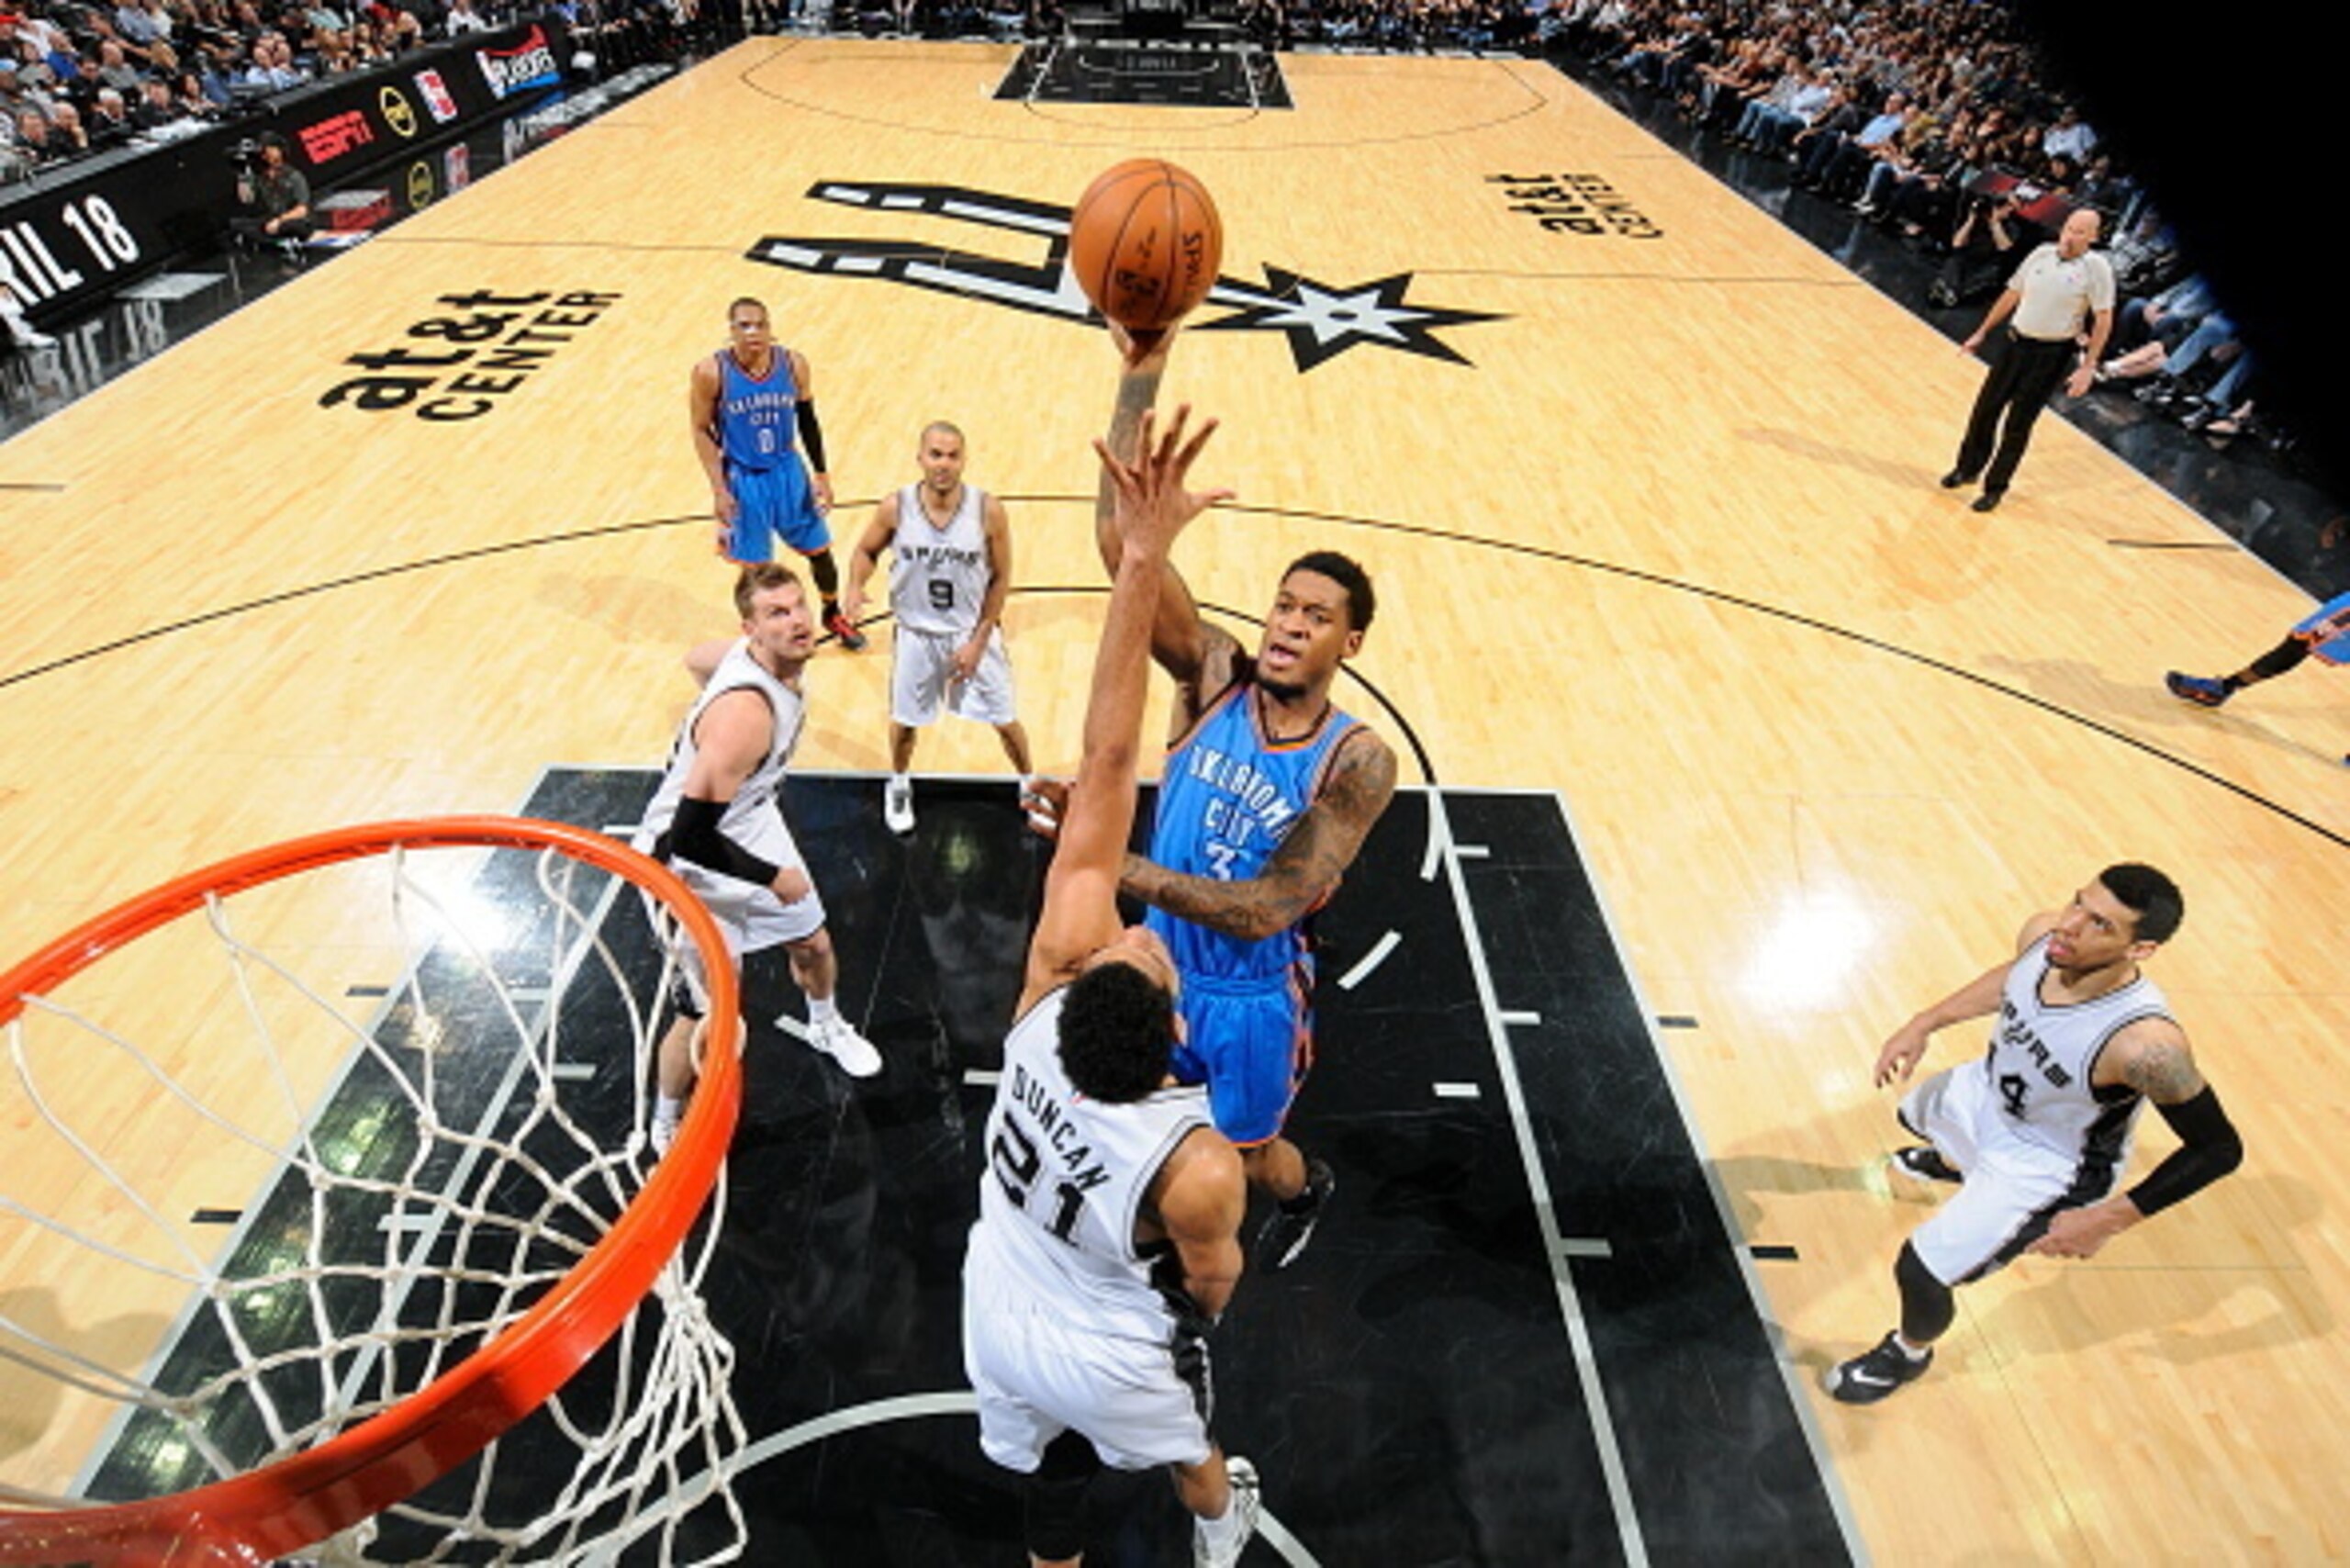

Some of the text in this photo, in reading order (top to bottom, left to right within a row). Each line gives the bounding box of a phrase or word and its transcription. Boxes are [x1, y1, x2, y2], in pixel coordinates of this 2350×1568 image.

[62, 194, 140, 272] 18
[317, 288, 553, 409] at&t
[415, 291, 624, 421] CENTER
[928, 578, 955, 611] 9
[991, 1109, 1085, 1249] 21
[1011, 1062, 1112, 1193] DUNCAN
